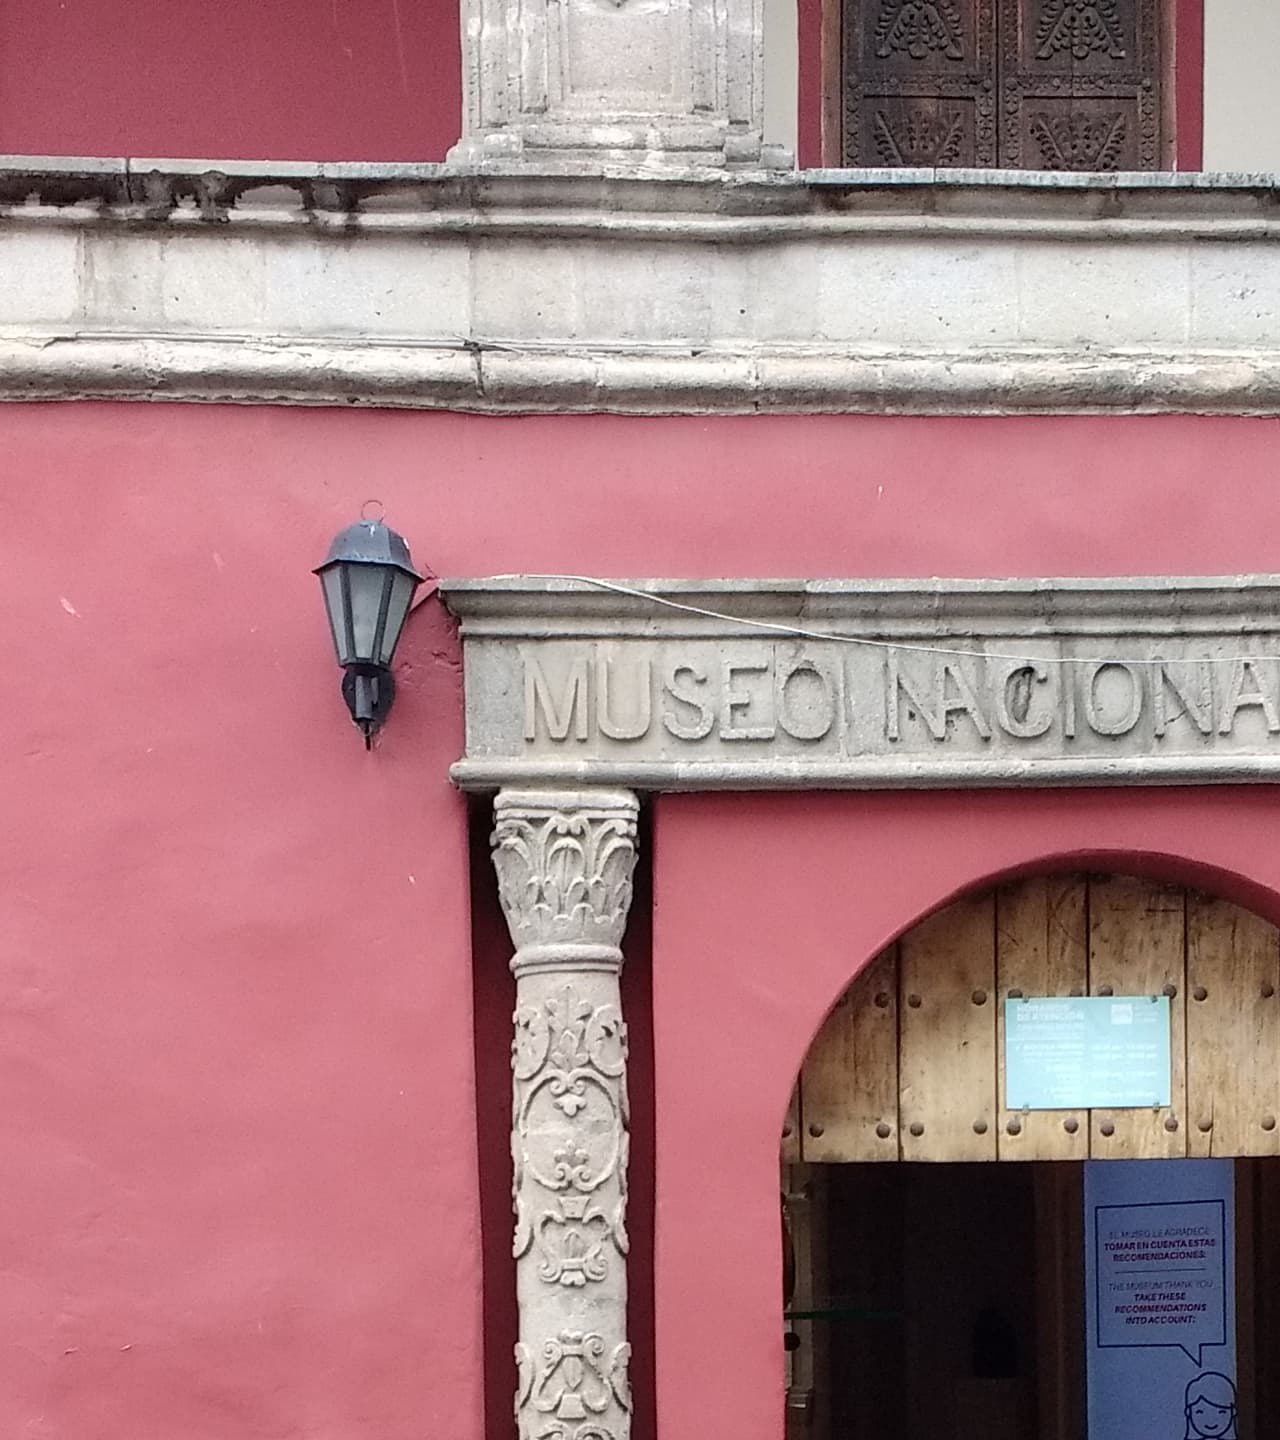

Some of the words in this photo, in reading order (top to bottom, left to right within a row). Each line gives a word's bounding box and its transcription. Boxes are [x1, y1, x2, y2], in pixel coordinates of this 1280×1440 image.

[522, 656, 835, 743] MUSEO
[1104, 1242, 1136, 1251] TOMAR
[1136, 1241, 1149, 1250] EN
[1150, 1240, 1187, 1249] CUENTA
[1187, 1239, 1217, 1248] ESTAS
[1133, 1293, 1157, 1302] TAKE
[1156, 1293, 1187, 1301] THESE
[1114, 1304, 1207, 1314] RECOMMENDATIONS
[1124, 1317, 1148, 1325] INTO
